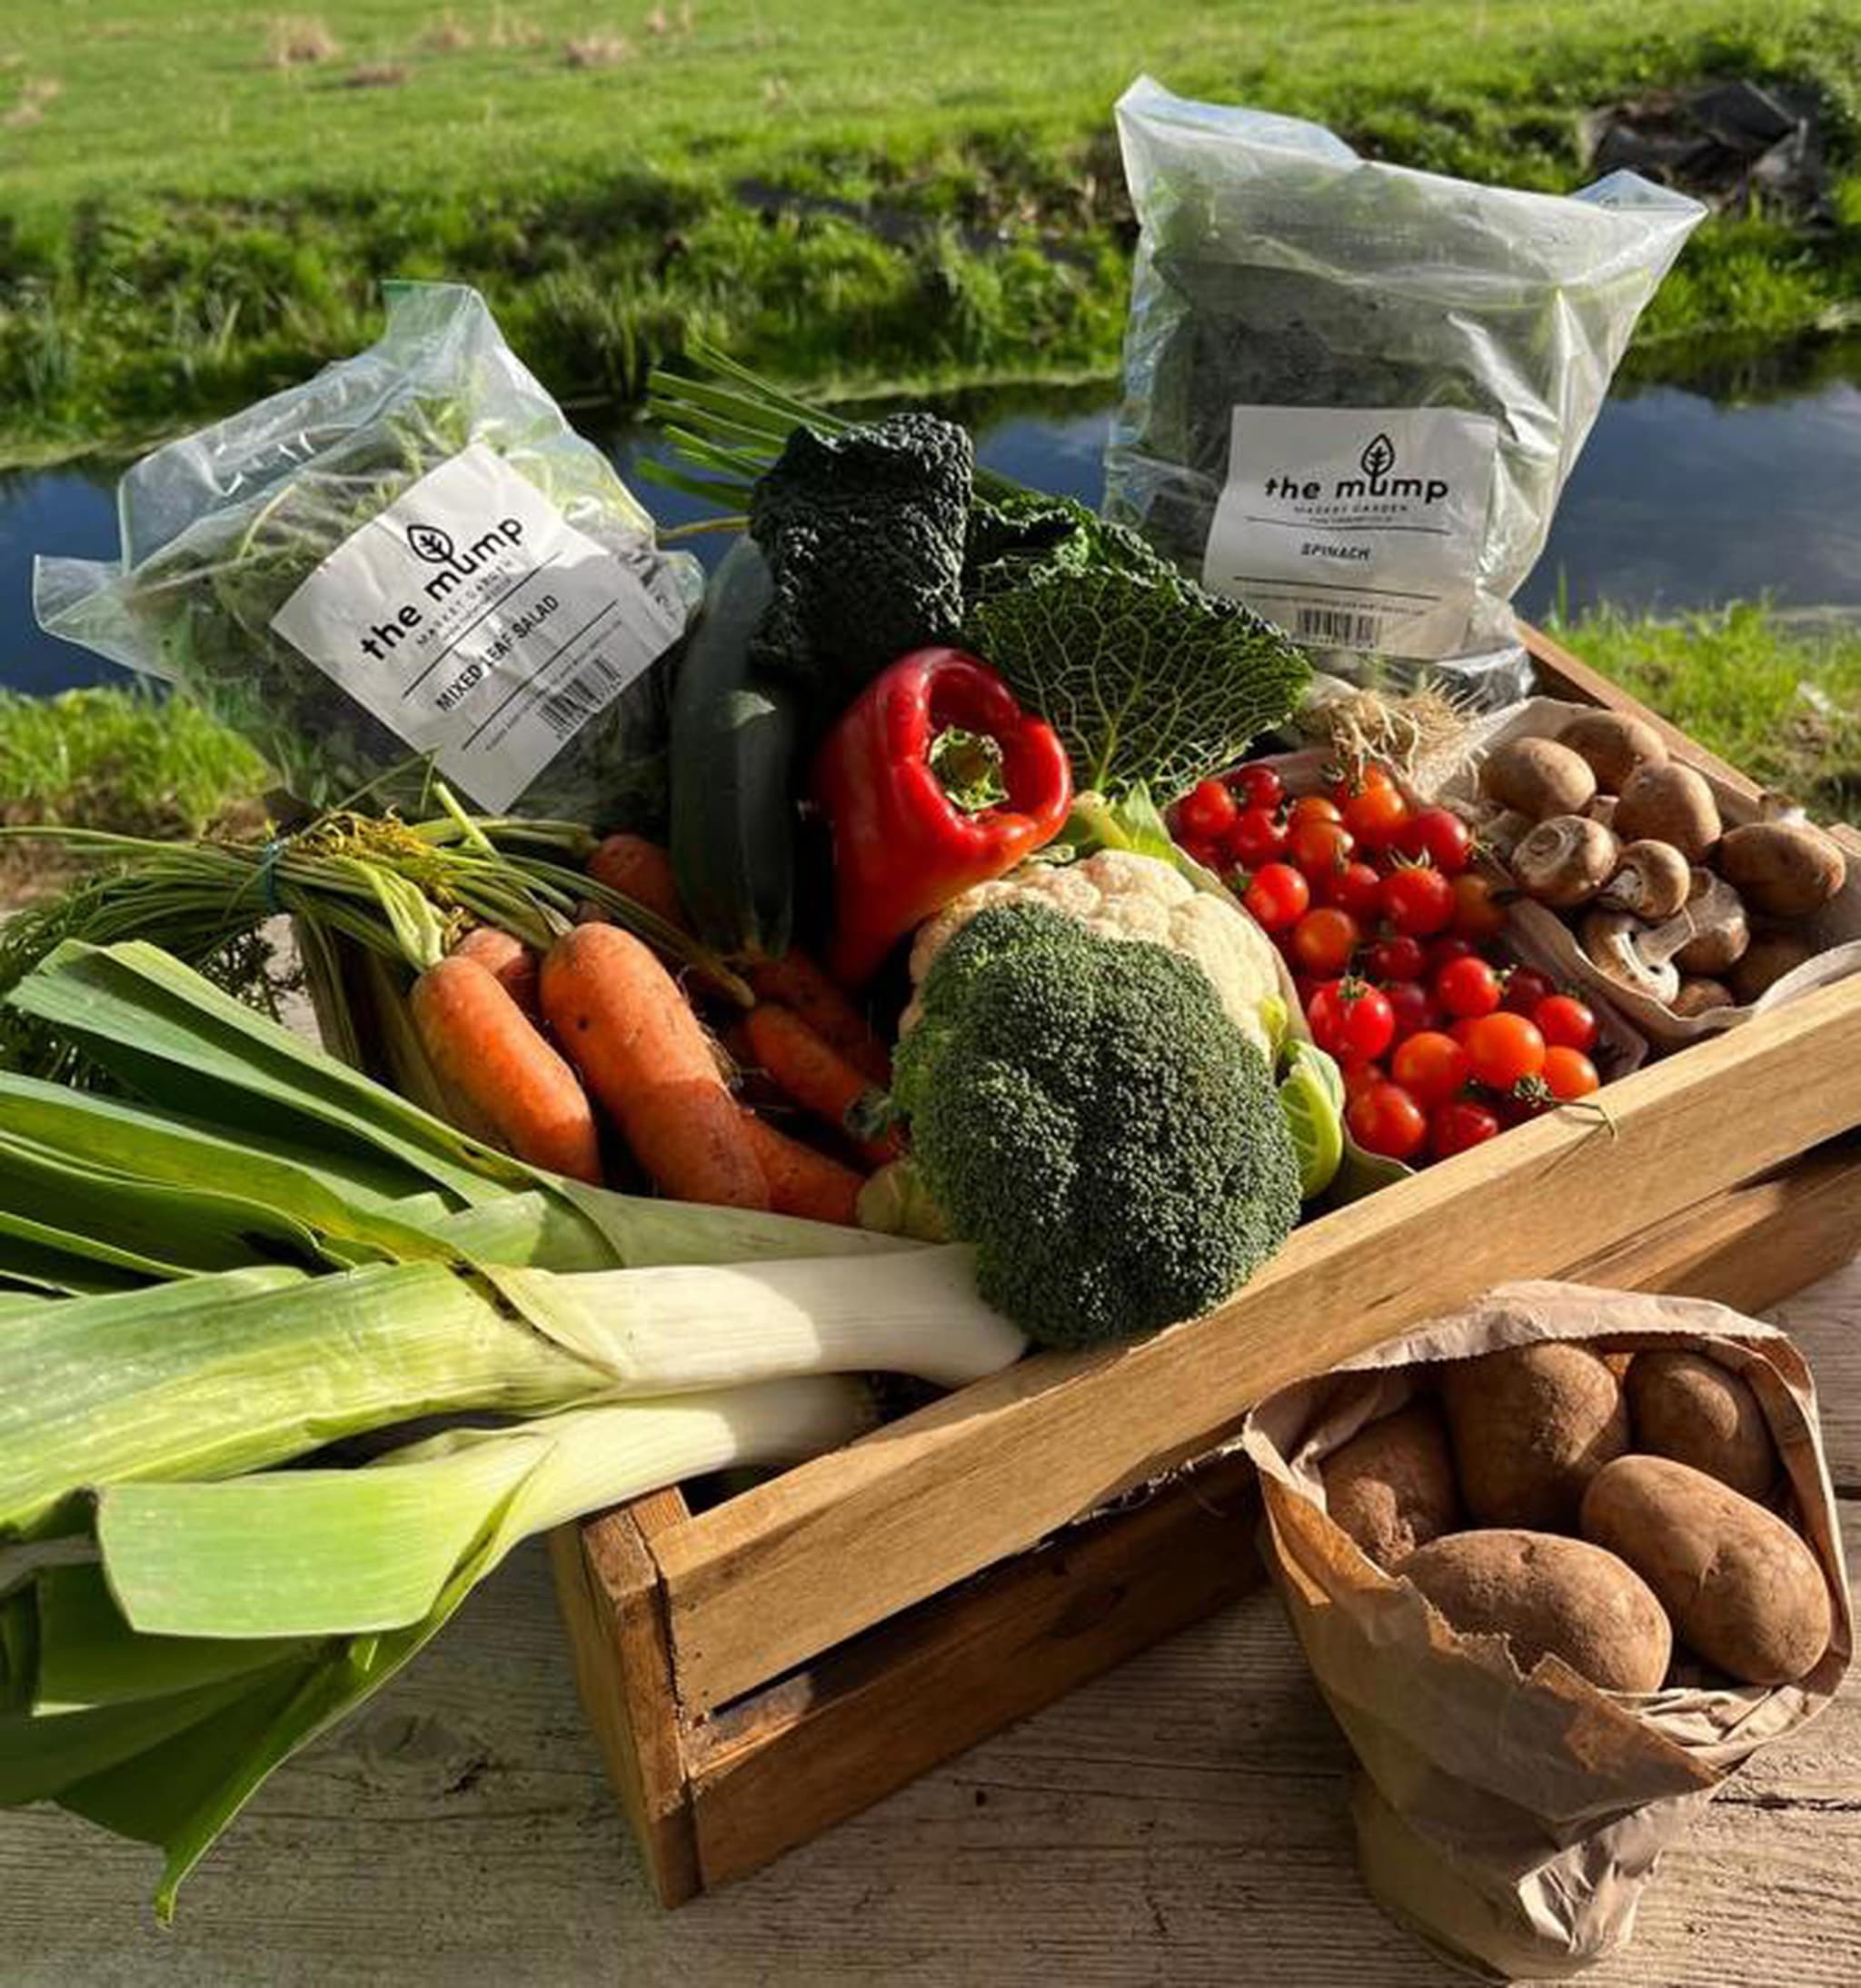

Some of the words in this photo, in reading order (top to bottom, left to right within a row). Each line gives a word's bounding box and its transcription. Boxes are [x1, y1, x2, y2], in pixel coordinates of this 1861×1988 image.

[1265, 477, 1320, 500] the
[1336, 478, 1448, 503] mump
[1301, 542, 1370, 560] SPINACH
[361, 605, 423, 661] the
[424, 519, 523, 602] mump
[436, 664, 484, 711] MIXED
[482, 634, 513, 668] LEAF
[512, 595, 560, 639] SALAD
